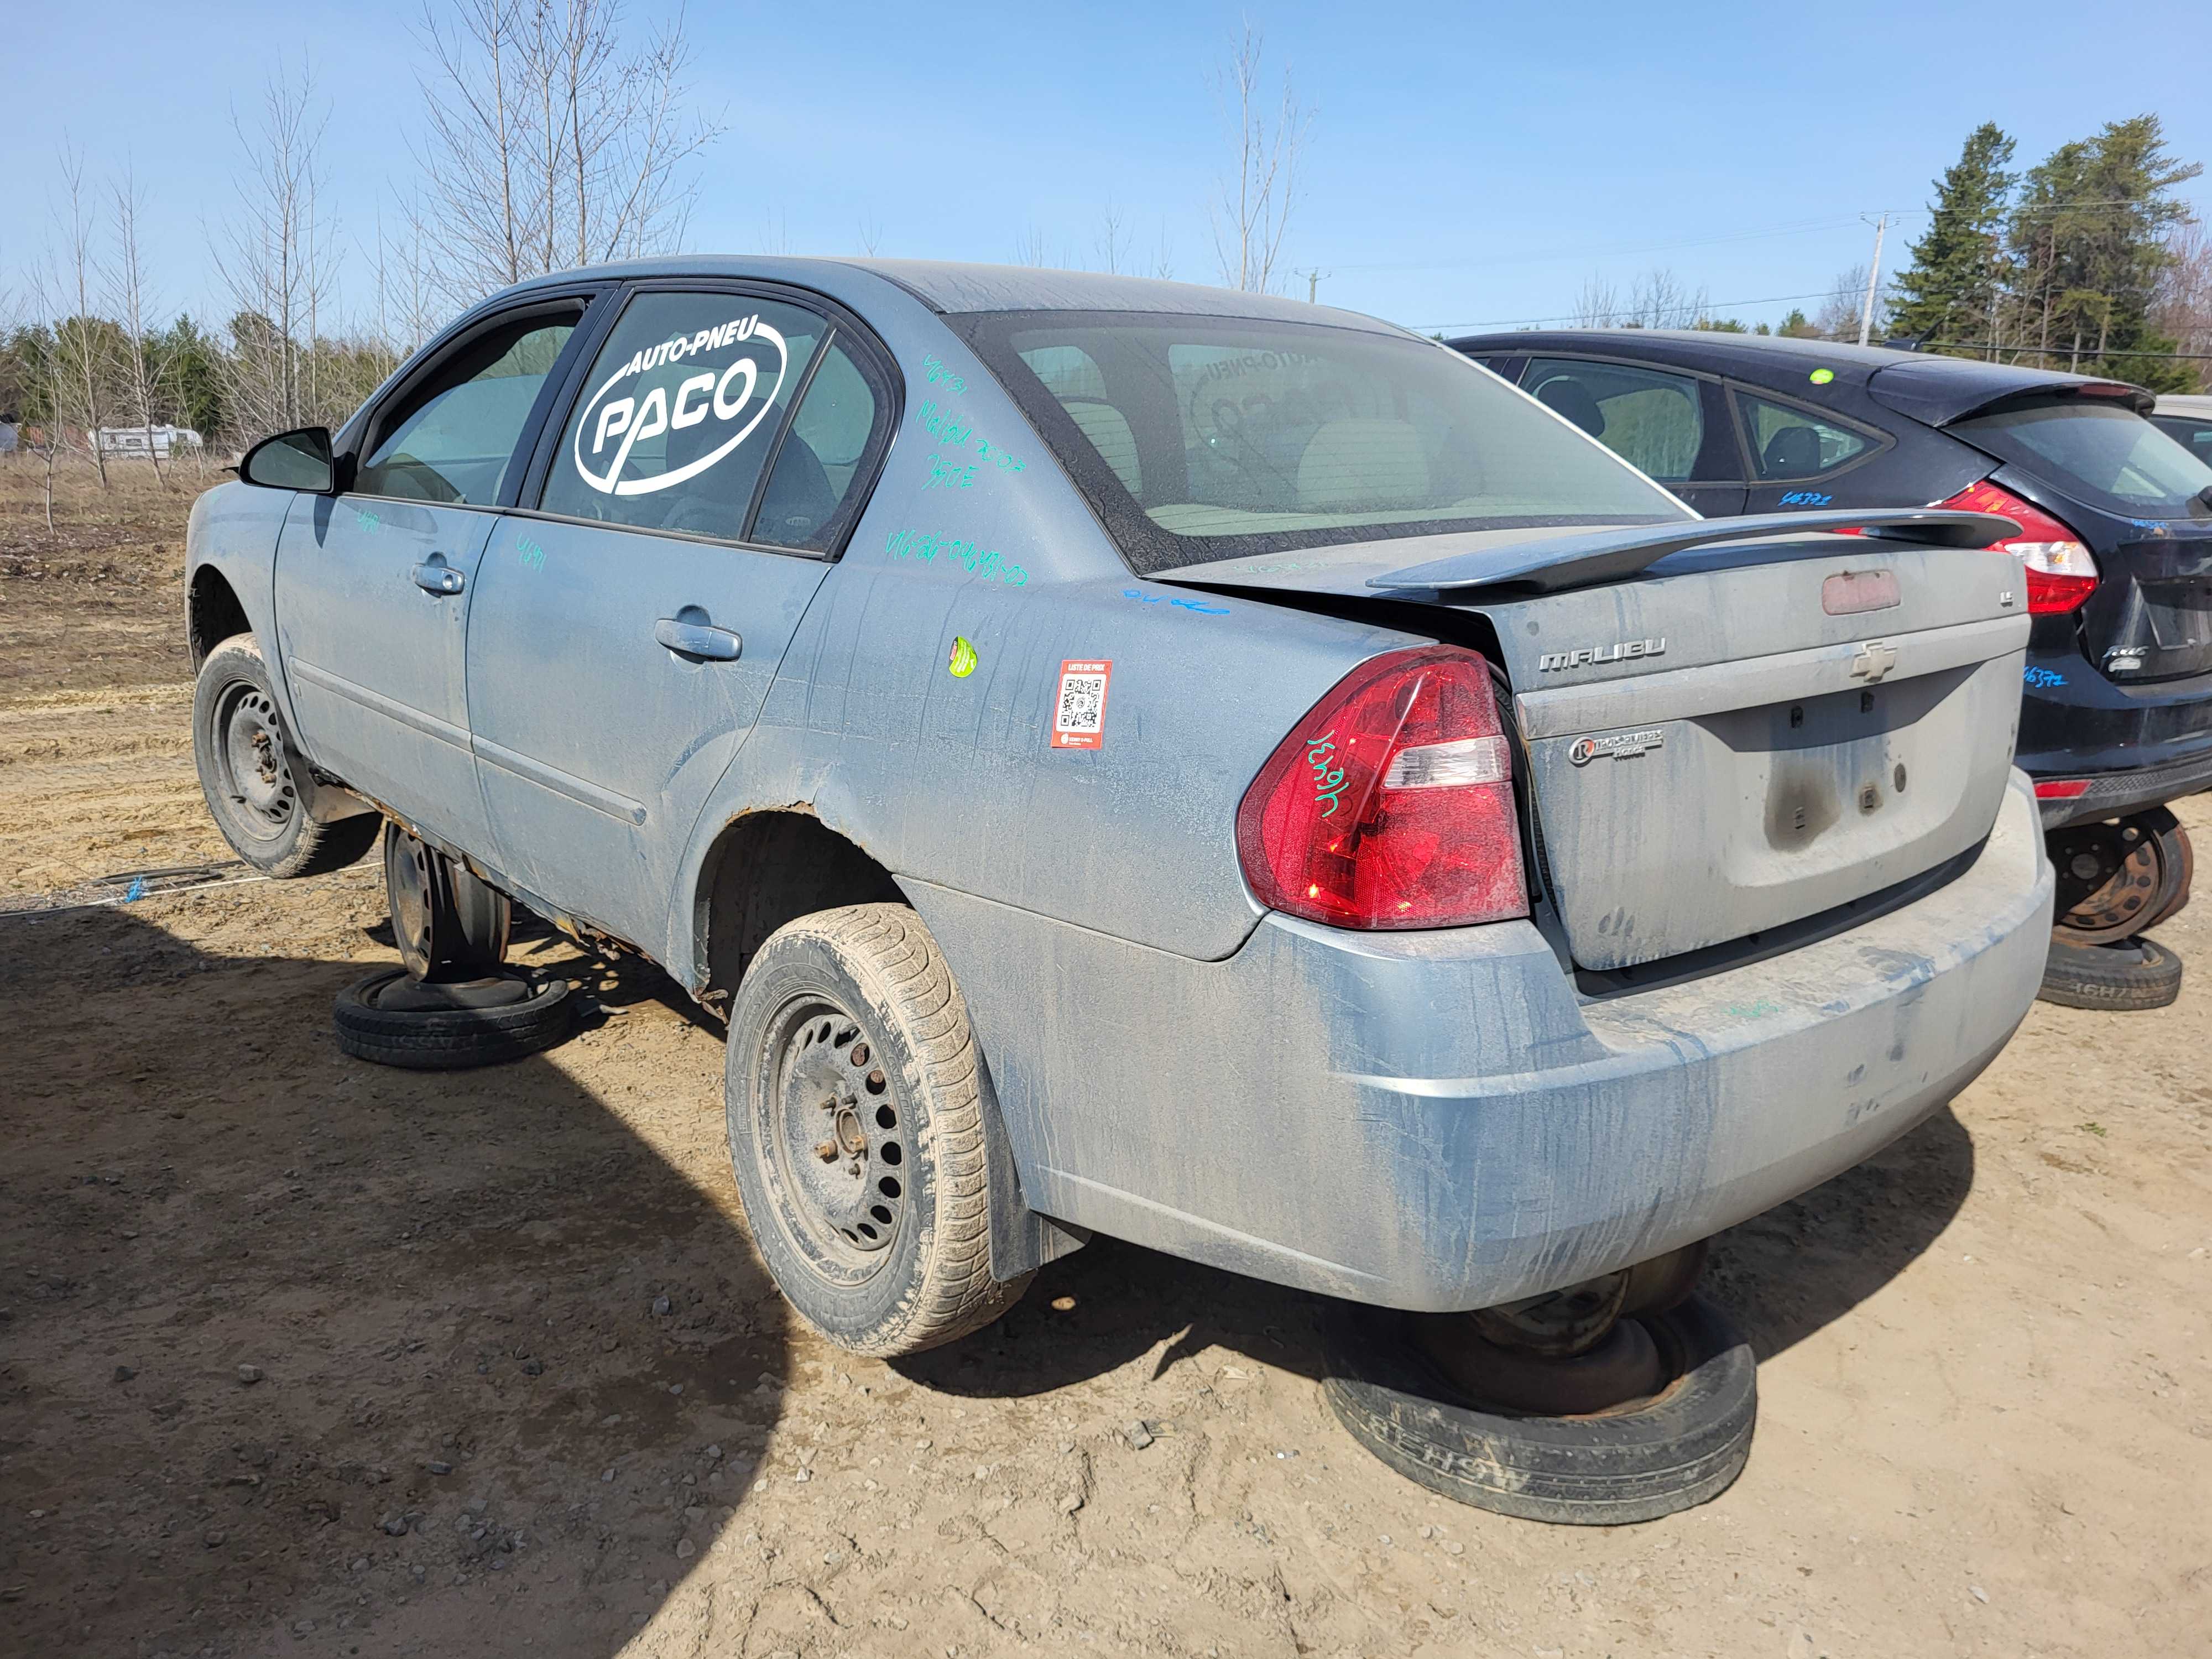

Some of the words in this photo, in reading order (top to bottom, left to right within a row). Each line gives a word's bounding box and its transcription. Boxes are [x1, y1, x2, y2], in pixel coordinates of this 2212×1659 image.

[625, 314, 758, 376] AUTO-PNEU
[592, 358, 757, 465] PACO
[1092, 663, 1105, 671] PRIX
[1539, 638, 1666, 671] MALIBU
